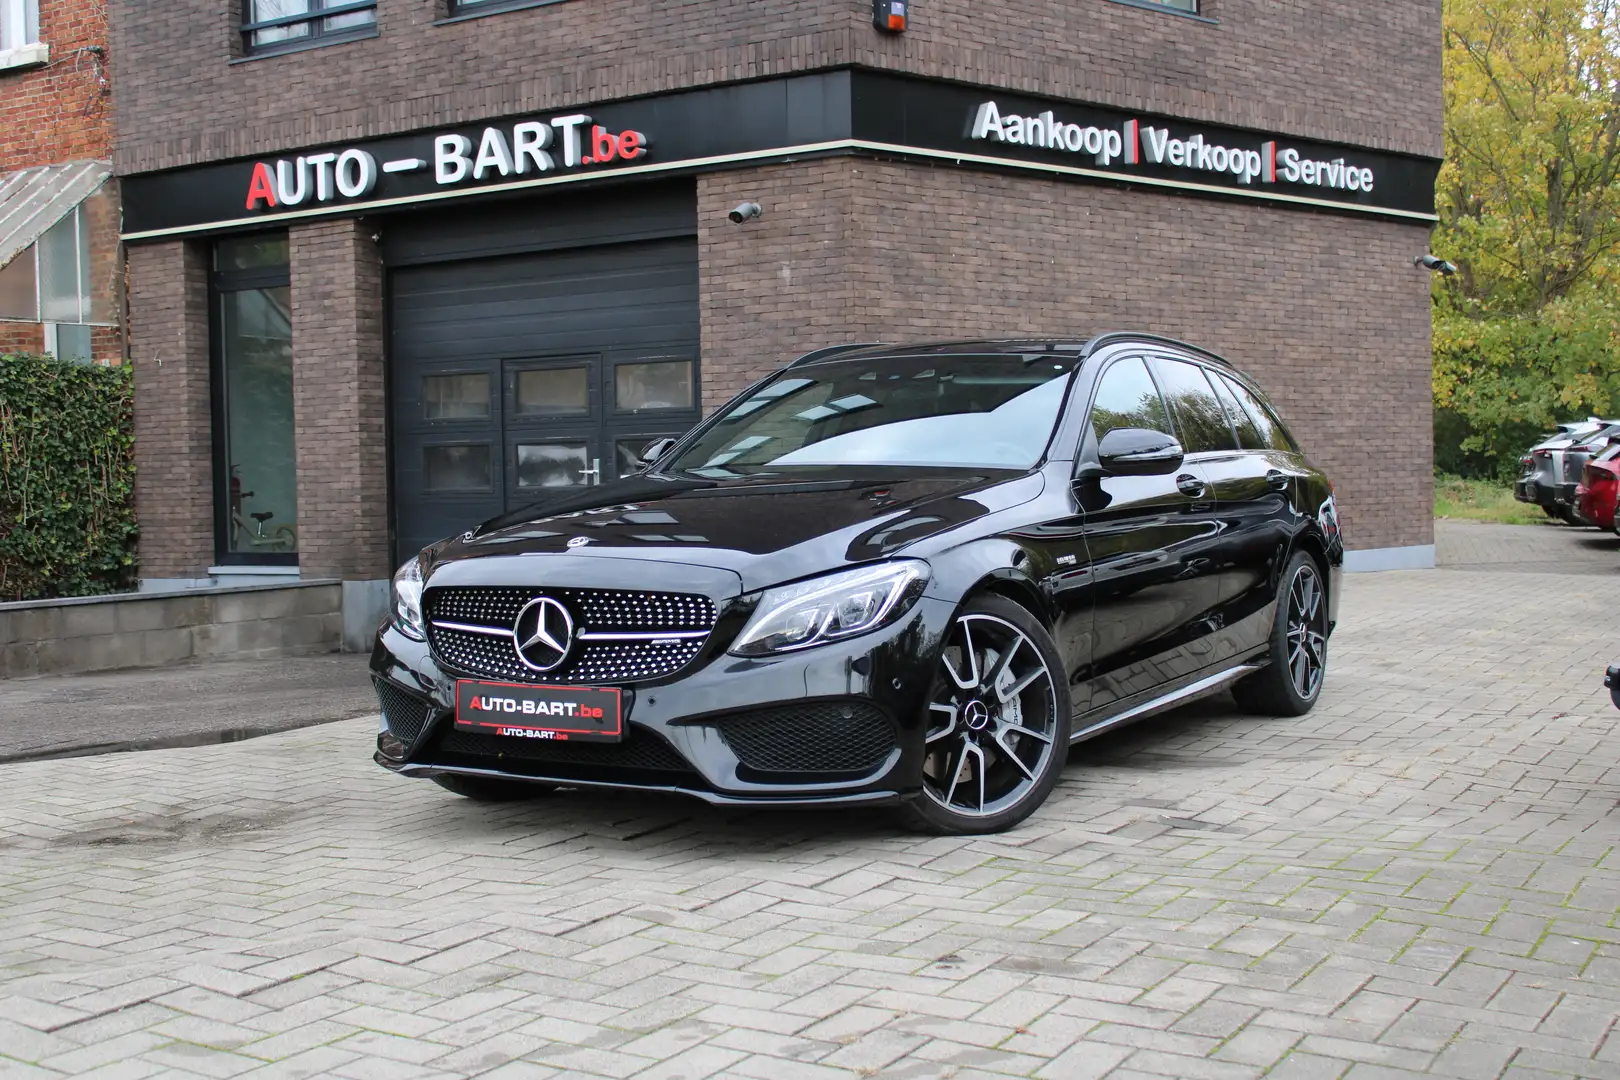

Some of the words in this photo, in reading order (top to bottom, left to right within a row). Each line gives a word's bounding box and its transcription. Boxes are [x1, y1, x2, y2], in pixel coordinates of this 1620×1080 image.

[246, 148, 373, 210] AUTO
[434, 113, 645, 184] BART.be
[975, 101, 1122, 166] Aankoop
[1143, 127, 1262, 185] Verkoop
[1279, 148, 1374, 193] Service
[469, 696, 603, 718] AUTO-BART.be
[496, 727, 569, 740] AUTO-BART.be
